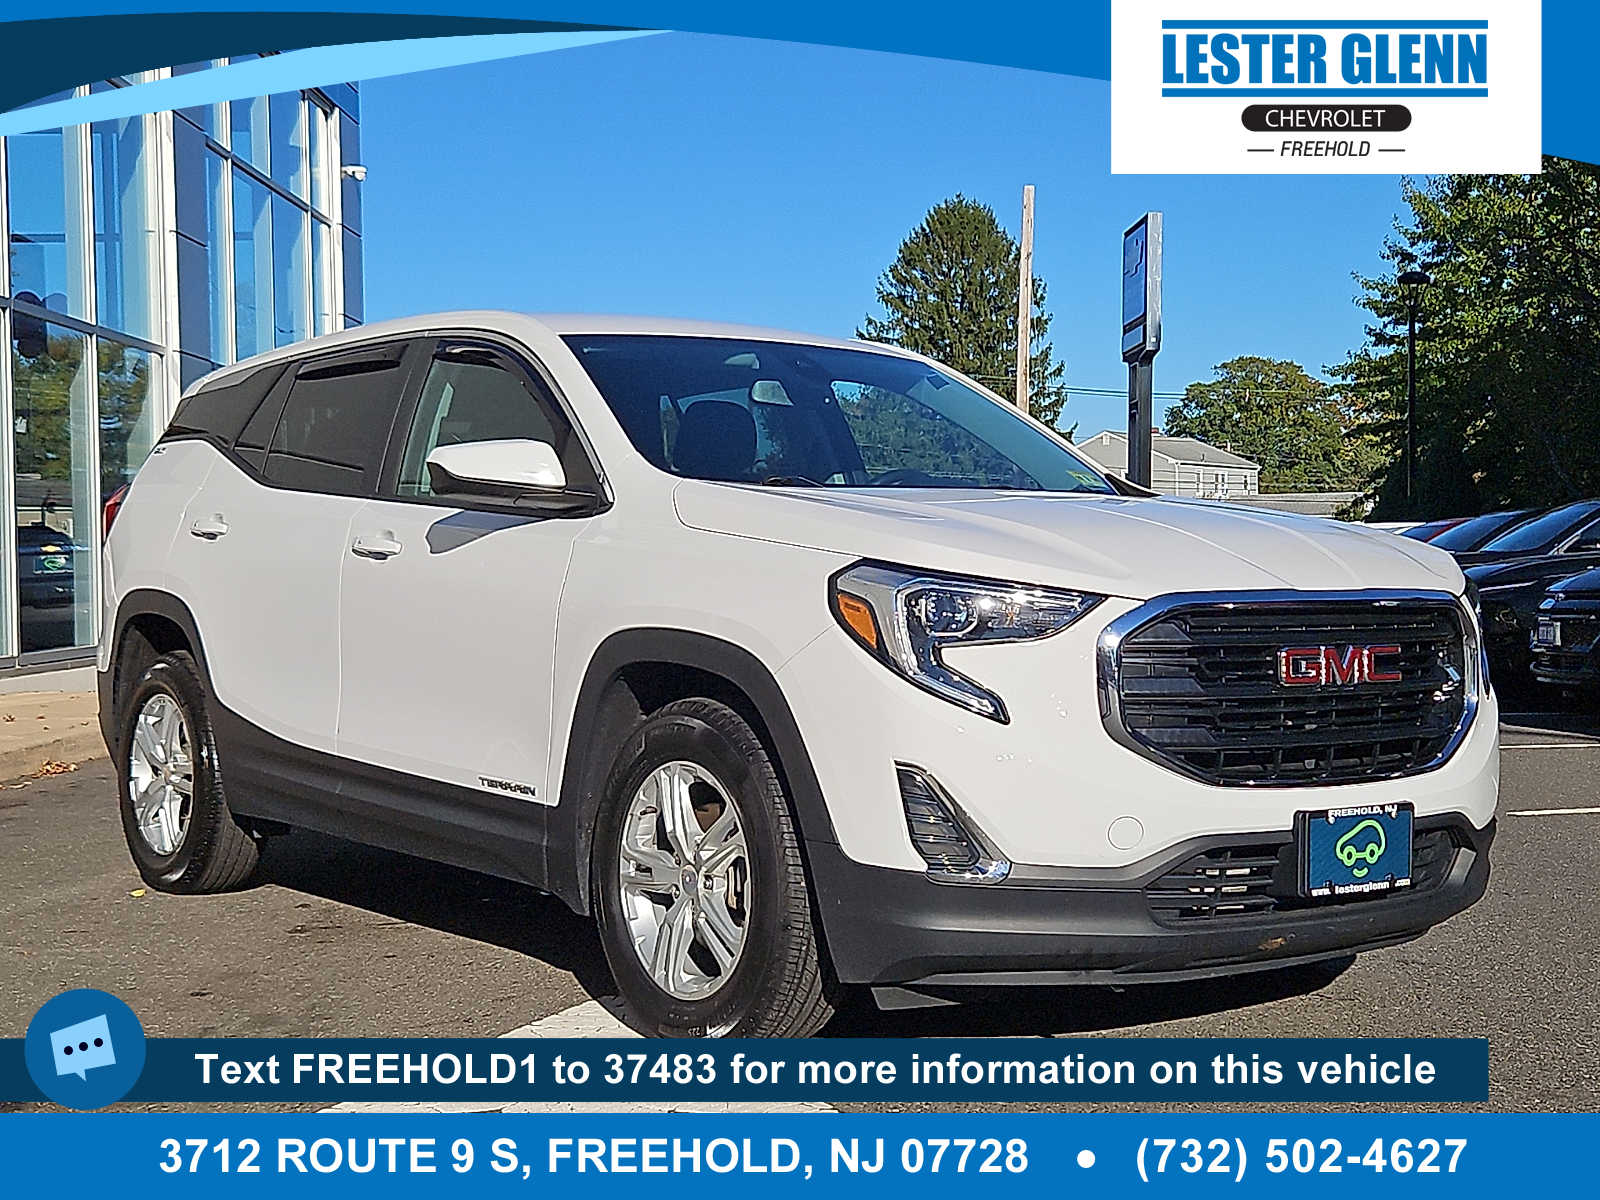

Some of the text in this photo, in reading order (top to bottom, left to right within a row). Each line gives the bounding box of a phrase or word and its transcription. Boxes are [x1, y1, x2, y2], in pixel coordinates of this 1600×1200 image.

[1277, 645, 1402, 687] GMC
[479, 776, 536, 797] TERRAIN
[1327, 804, 1398, 819] FREEHOLD, NJ
